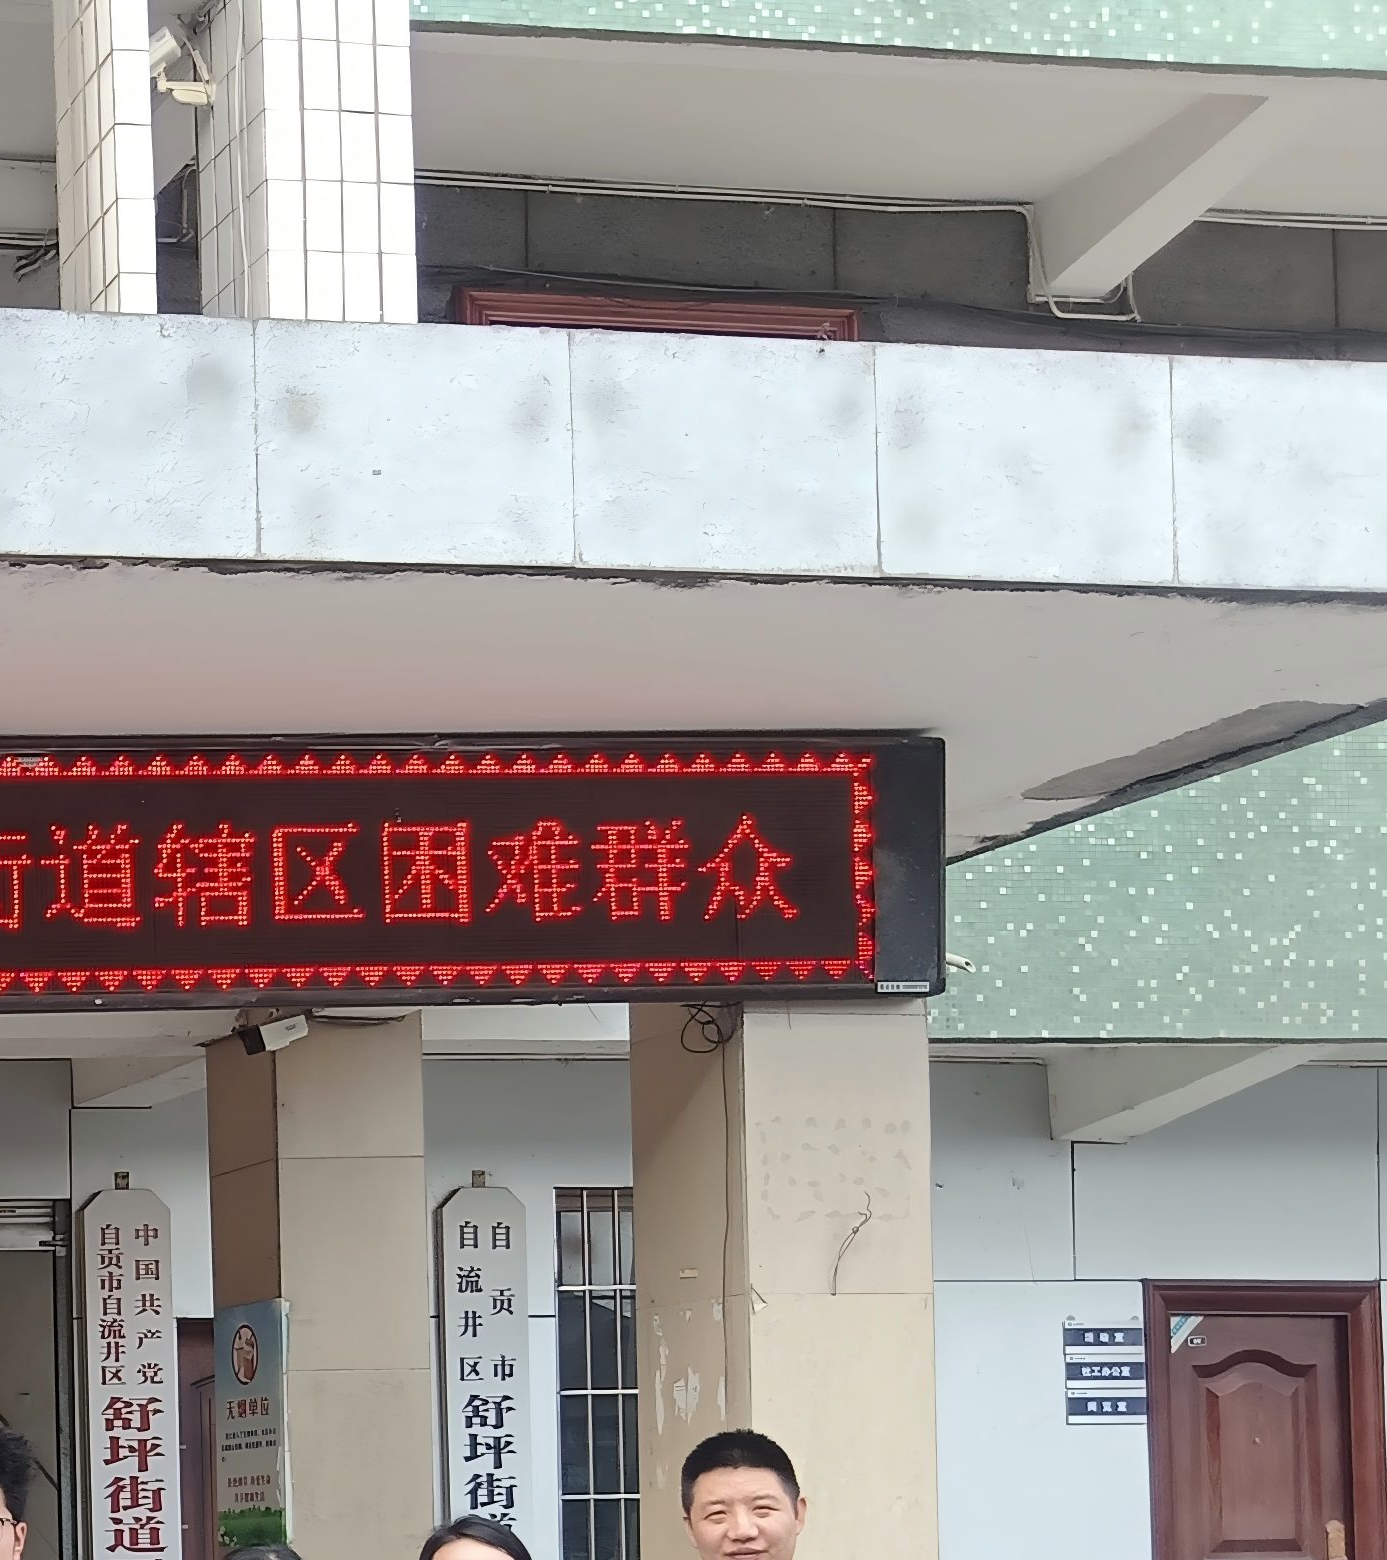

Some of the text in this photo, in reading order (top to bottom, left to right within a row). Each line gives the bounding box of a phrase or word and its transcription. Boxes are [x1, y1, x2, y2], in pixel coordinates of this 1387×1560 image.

[97, 1223, 127, 1386] 自贡市自流井区
[134, 1223, 164, 1385] 中国共产党
[456, 1221, 484, 1381] 自流井区
[490, 1221, 517, 1381] 自贡市
[461, 1394, 518, 1533] 舒坪街
